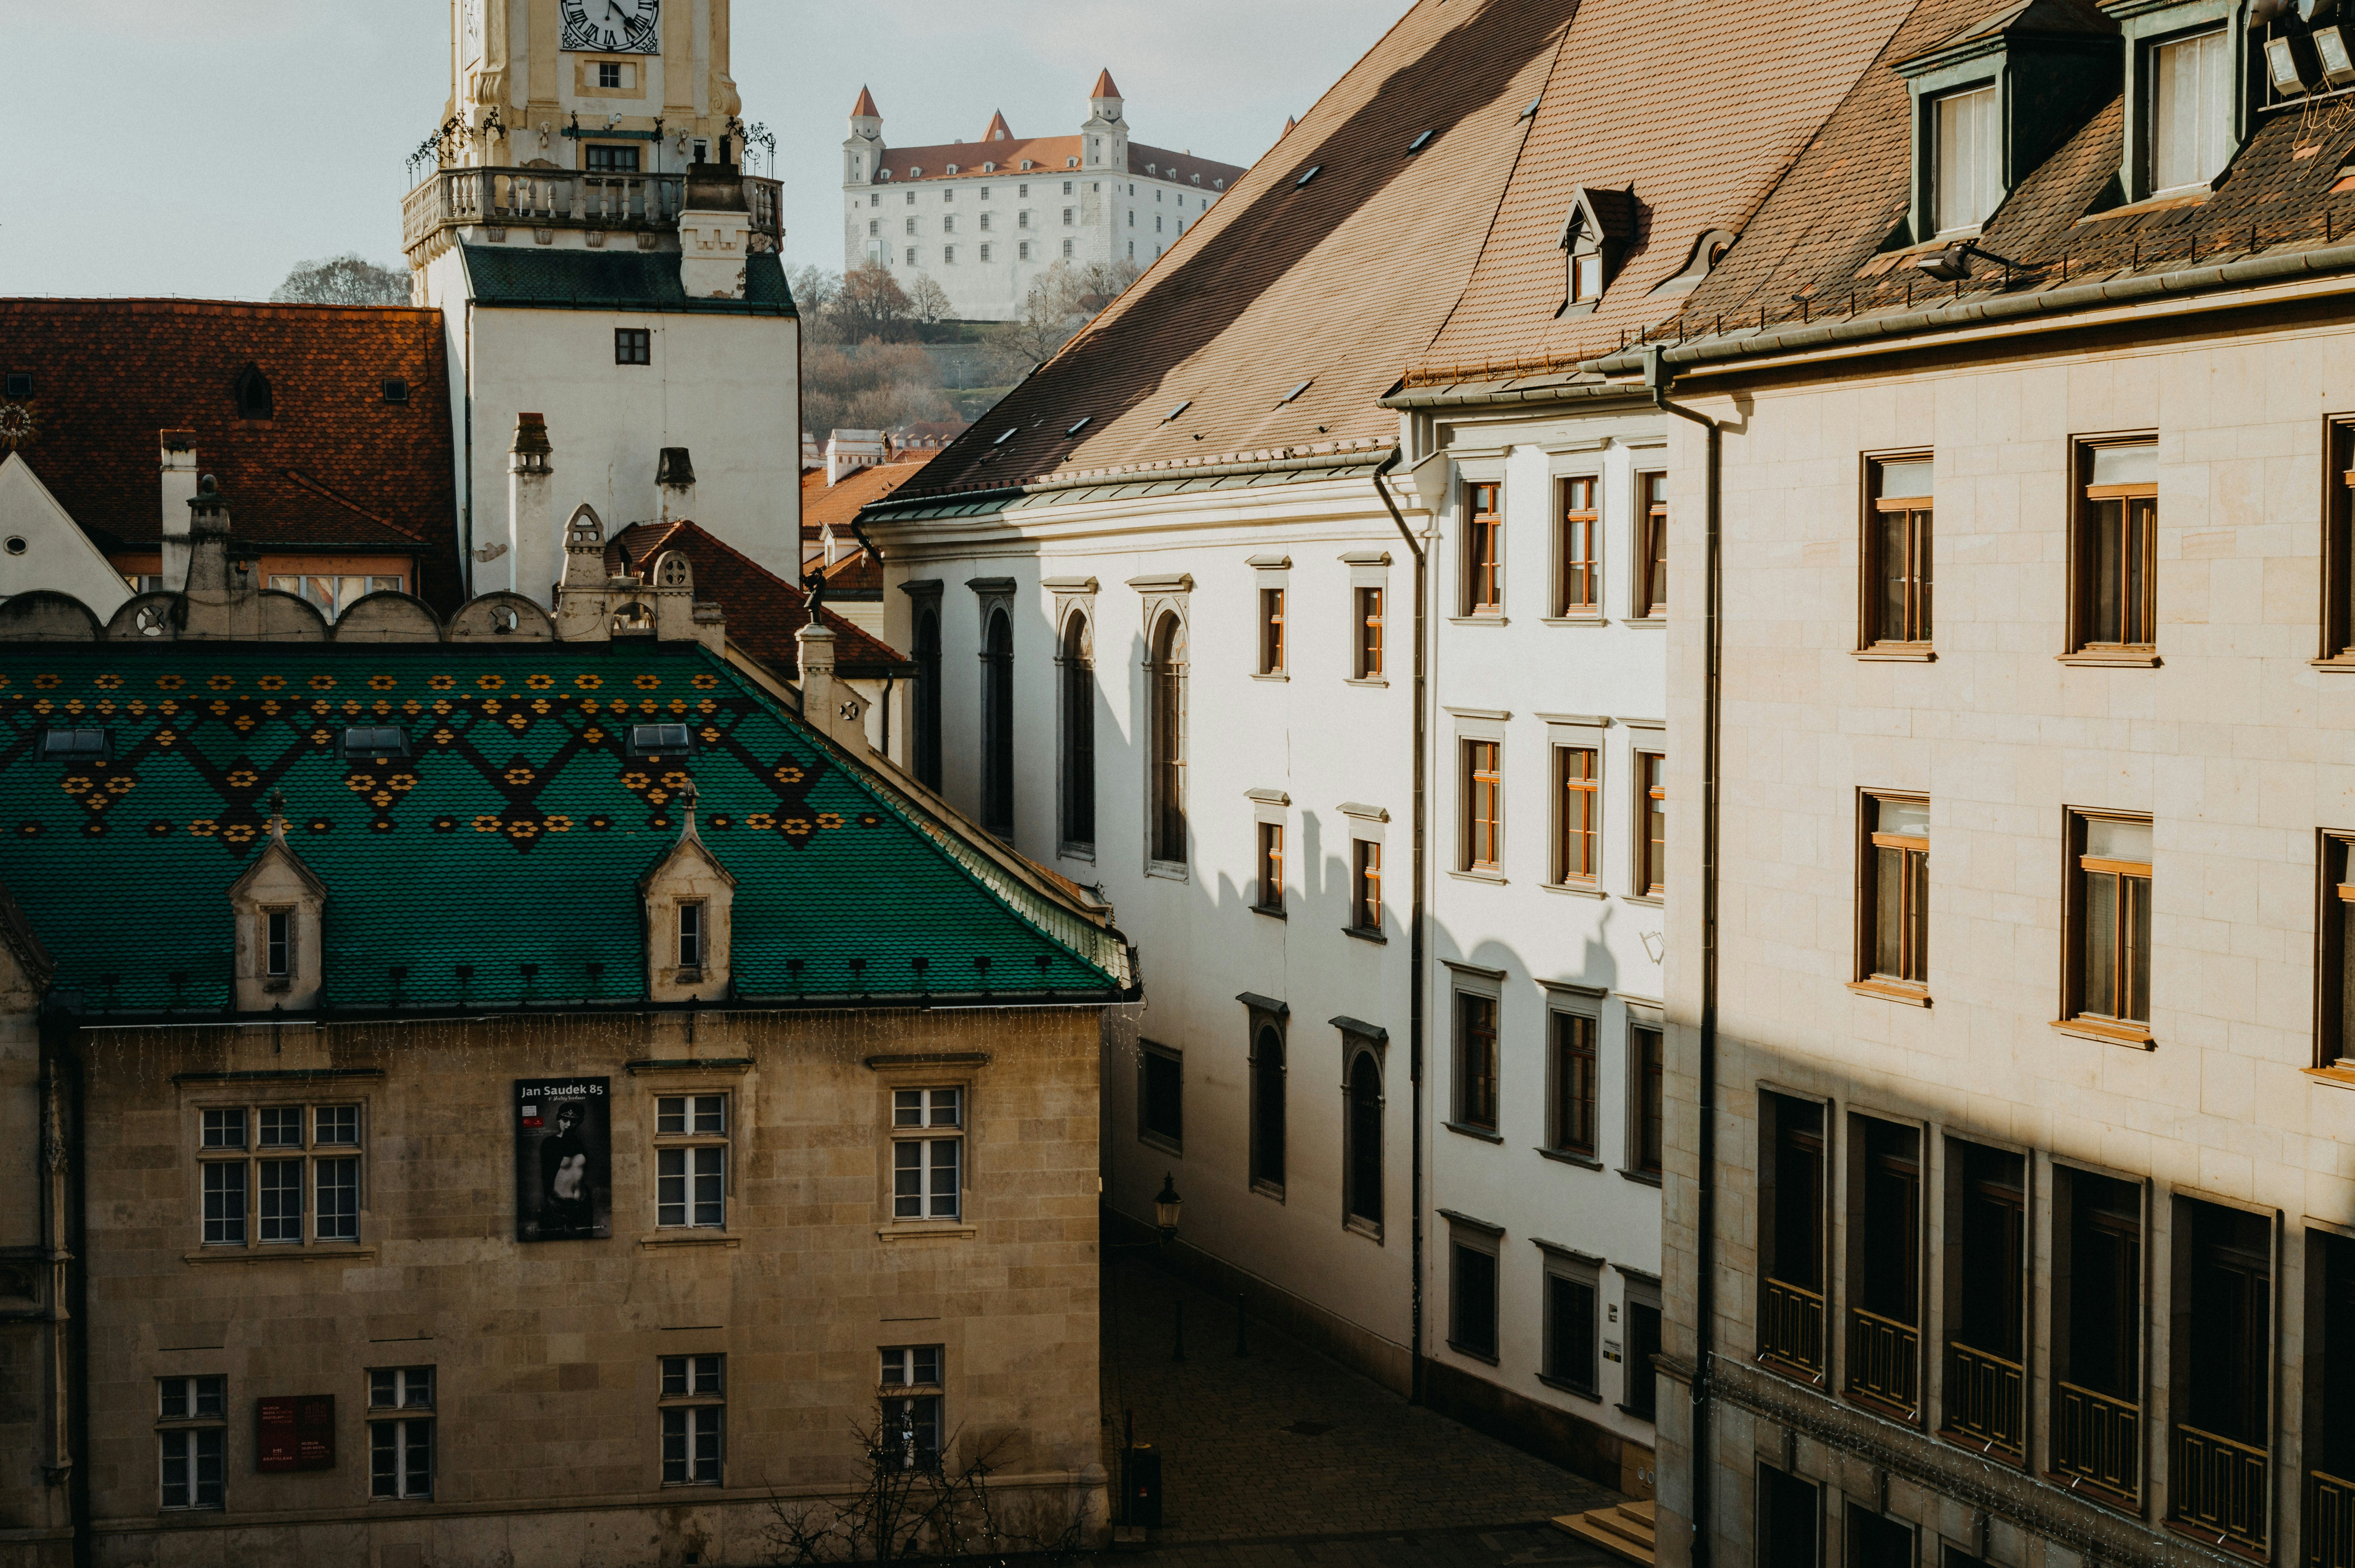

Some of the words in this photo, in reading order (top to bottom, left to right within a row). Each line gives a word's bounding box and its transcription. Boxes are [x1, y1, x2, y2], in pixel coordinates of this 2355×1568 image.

[521, 1087, 540, 1098] Jan
[544, 1084, 587, 1095] Saudek
[590, 1084, 603, 1095] 85
